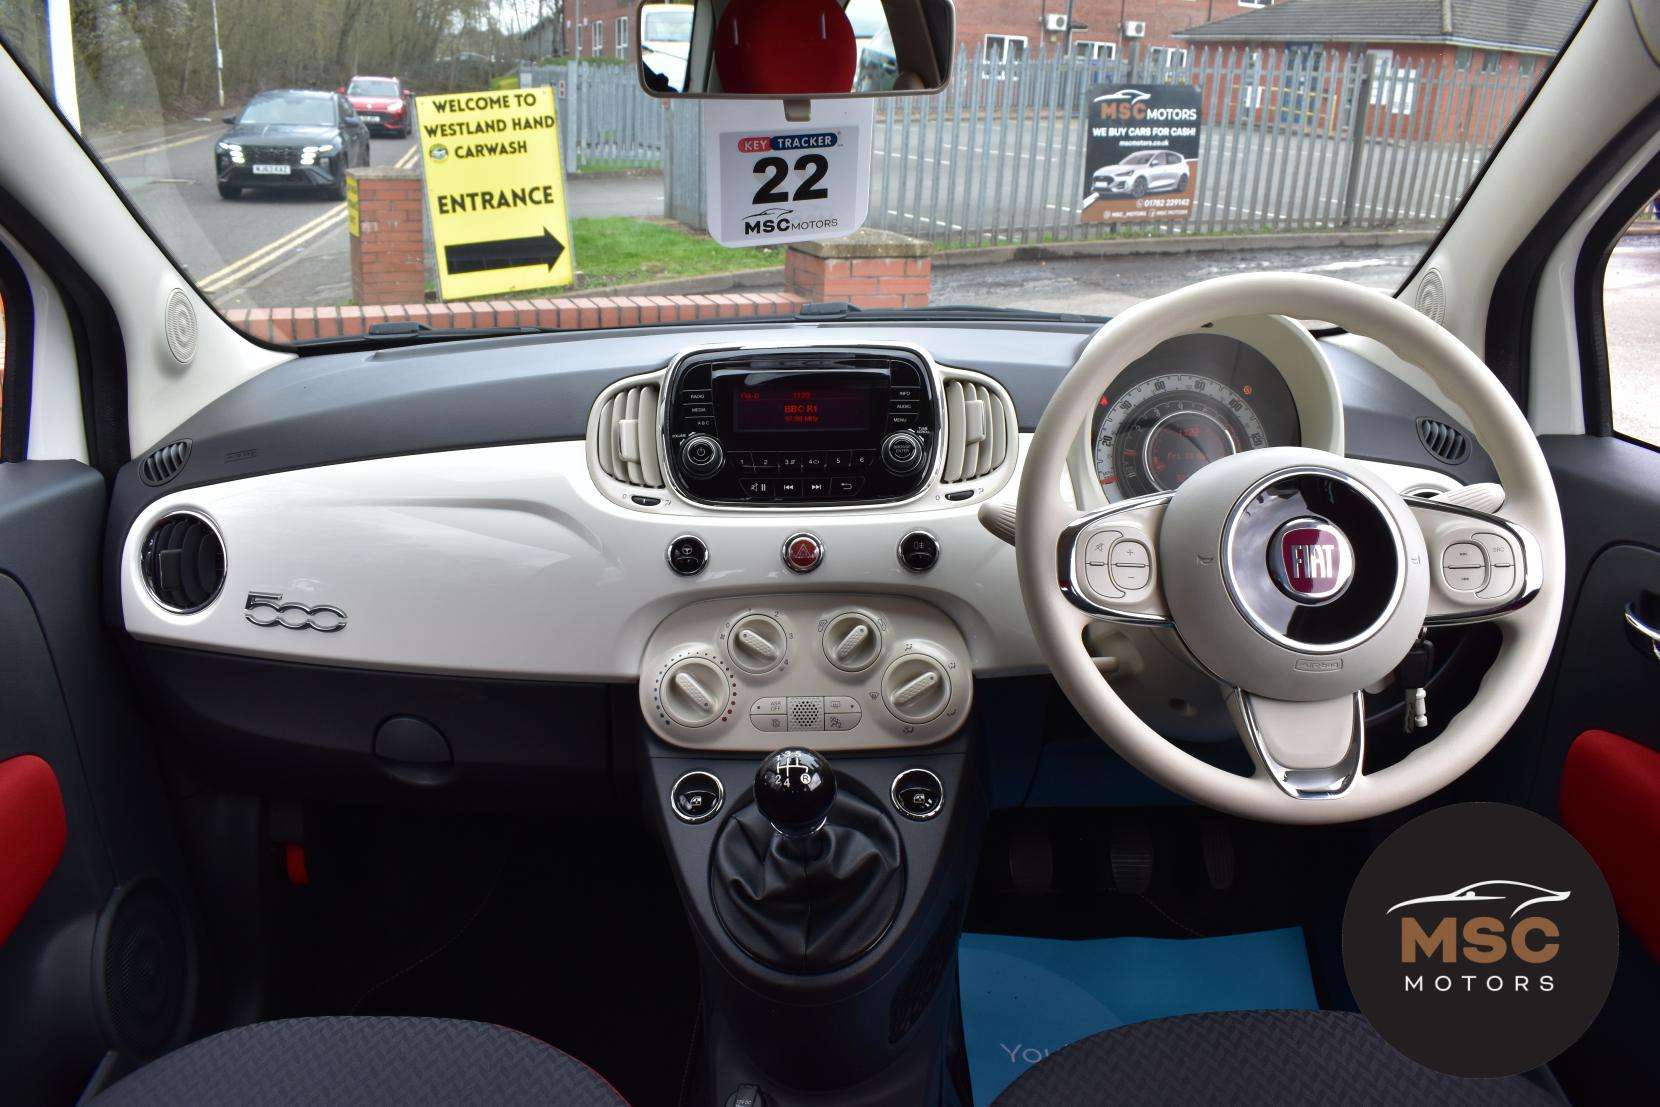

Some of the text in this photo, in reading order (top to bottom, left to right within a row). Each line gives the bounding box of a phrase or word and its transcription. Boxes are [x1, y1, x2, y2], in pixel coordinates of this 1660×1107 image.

[432, 93, 537, 113] WELCOME TO
[1100, 102, 1197, 120] MSC MOTORS
[424, 115, 555, 138] WESTLAND HAND
[1092, 127, 1197, 137] WE BUY CARS FOR CASH!
[454, 140, 528, 159] CARWASH
[744, 136, 833, 151] KEY TRACKER
[752, 153, 829, 205] 22
[437, 185, 555, 214] ENTRANCE
[744, 218, 838, 235] MSC MOTORS
[1101, 435, 1114, 448] 20
[1291, 544, 1335, 579] FIAT
[245, 591, 348, 633] 500
[775, 774, 782, 785] 2
[783, 778, 791, 788] 4
